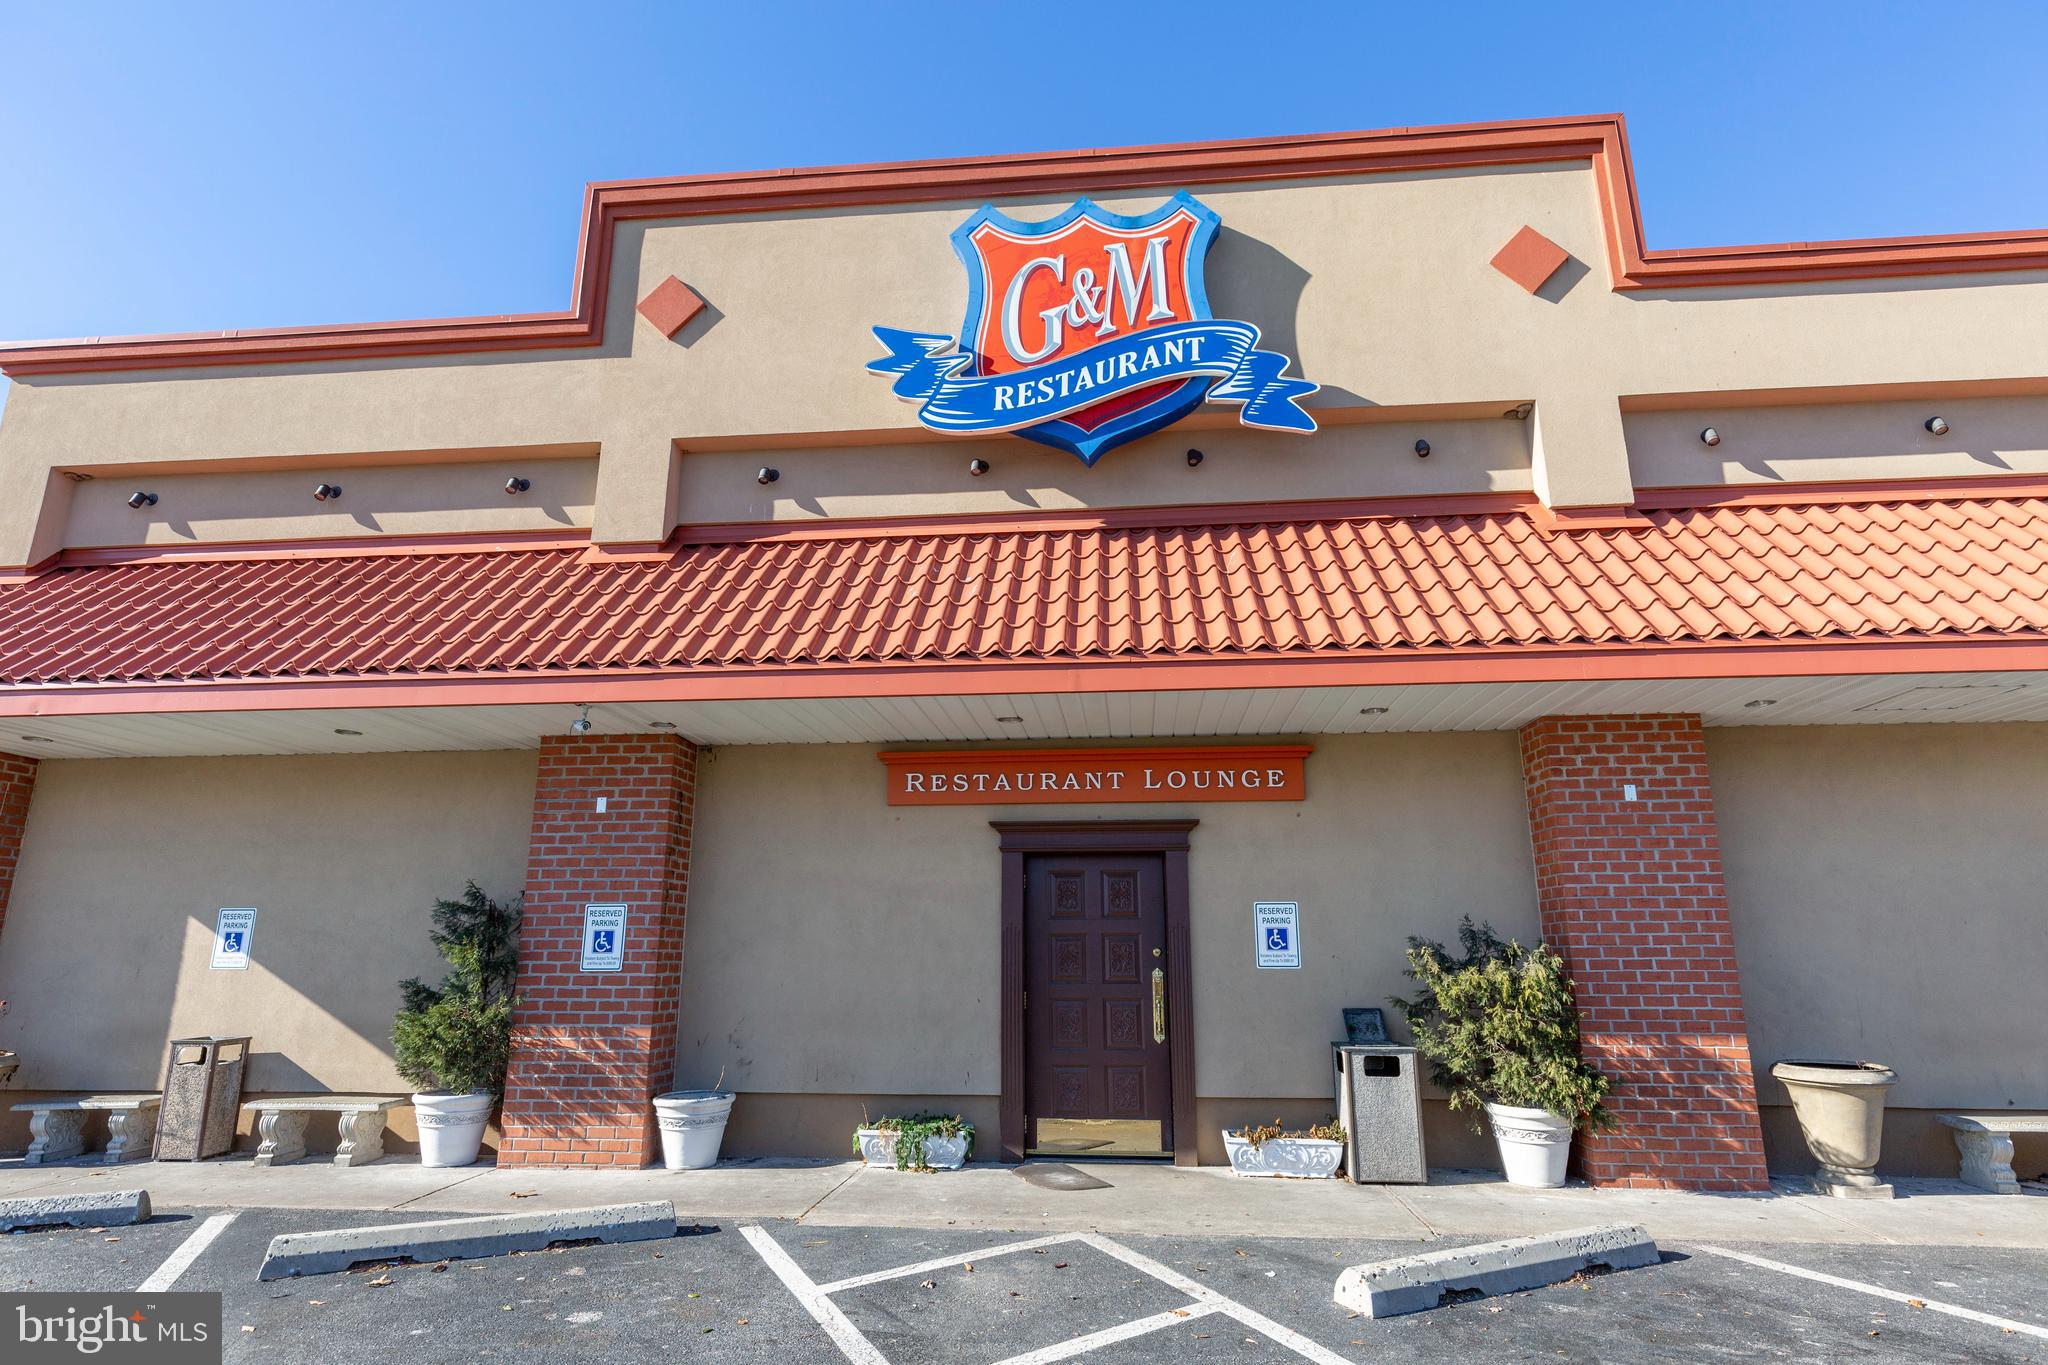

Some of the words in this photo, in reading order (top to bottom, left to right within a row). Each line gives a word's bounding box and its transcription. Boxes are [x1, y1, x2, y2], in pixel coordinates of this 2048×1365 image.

[1001, 236, 1177, 364] G&M
[993, 336, 1206, 412] RESTAURANT
[904, 771, 1126, 793] RESTAURANT
[1143, 769, 1286, 789] LOUNGE
[589, 909, 623, 918] RESERVED
[1258, 907, 1294, 915] RESERVED
[591, 919, 619, 927] PARKING
[1262, 917, 1291, 925] PARKING
